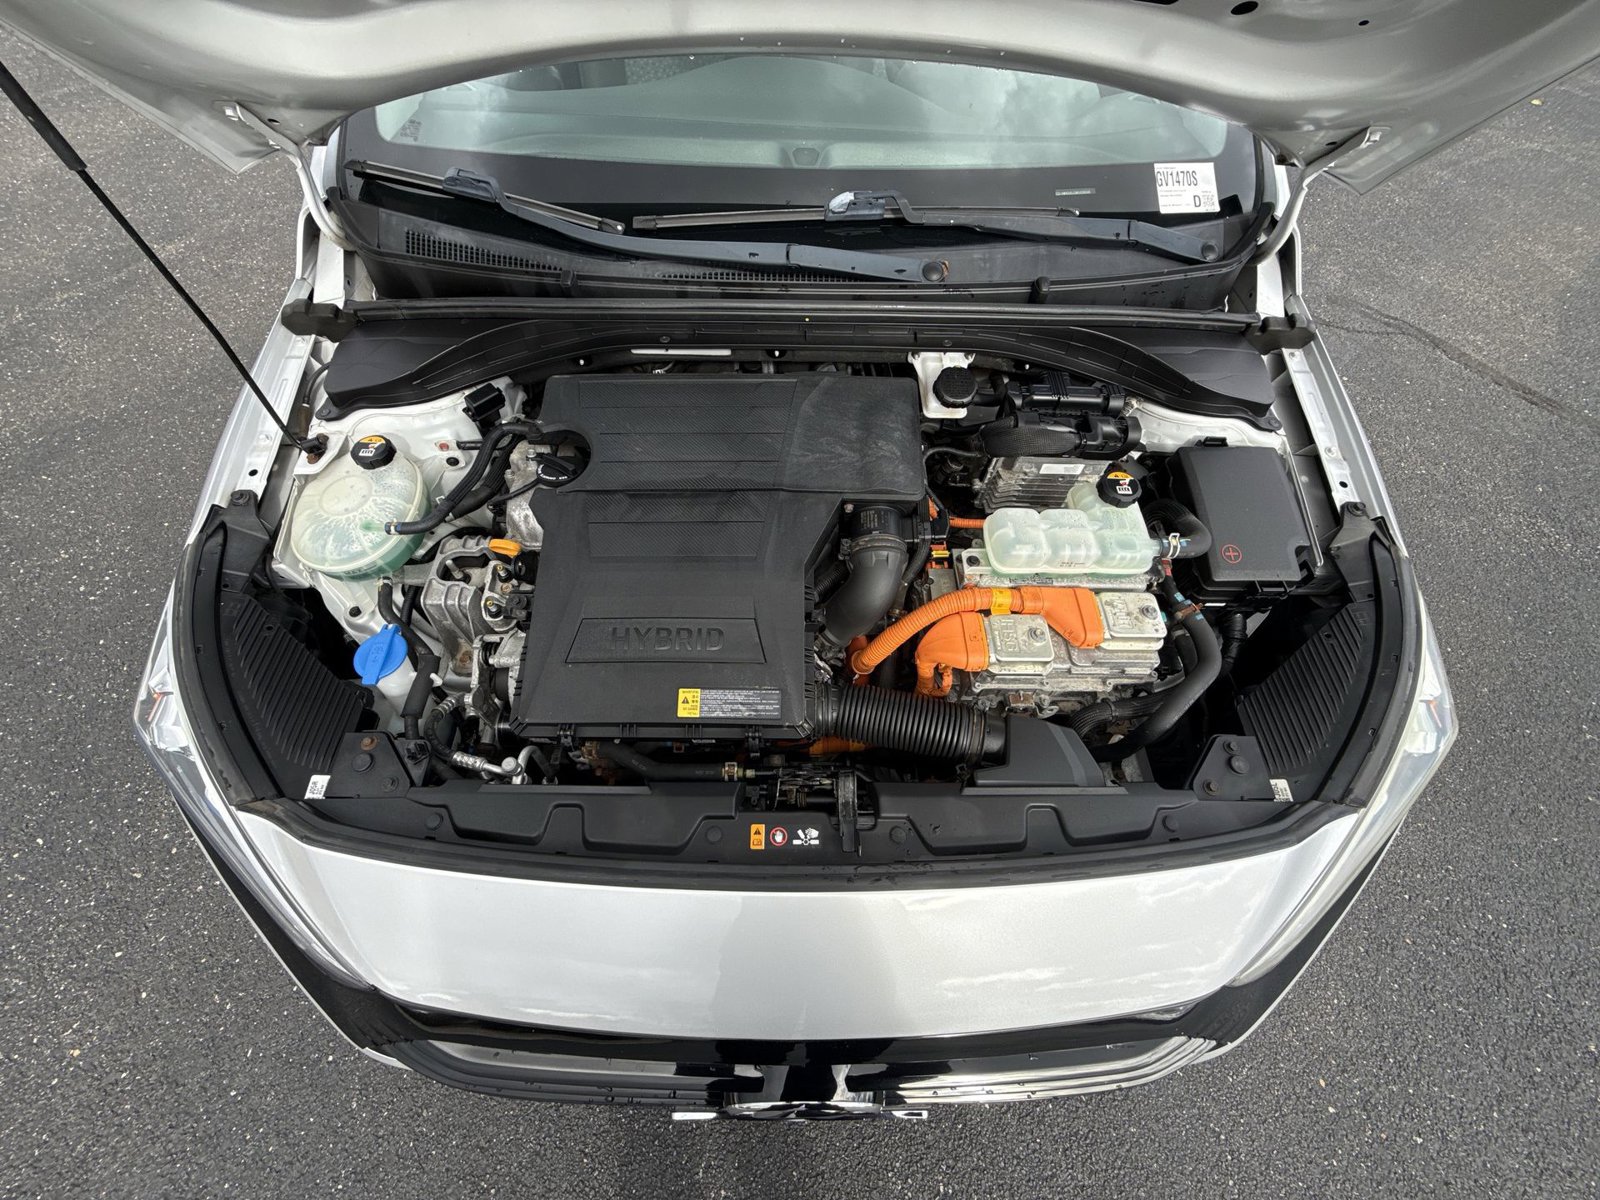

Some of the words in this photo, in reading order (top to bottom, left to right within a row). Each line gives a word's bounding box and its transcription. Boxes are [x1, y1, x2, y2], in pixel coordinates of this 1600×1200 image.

[1156, 170, 1198, 187] GV1470S
[1193, 195, 1201, 208] D
[611, 626, 725, 650] HYBRID
